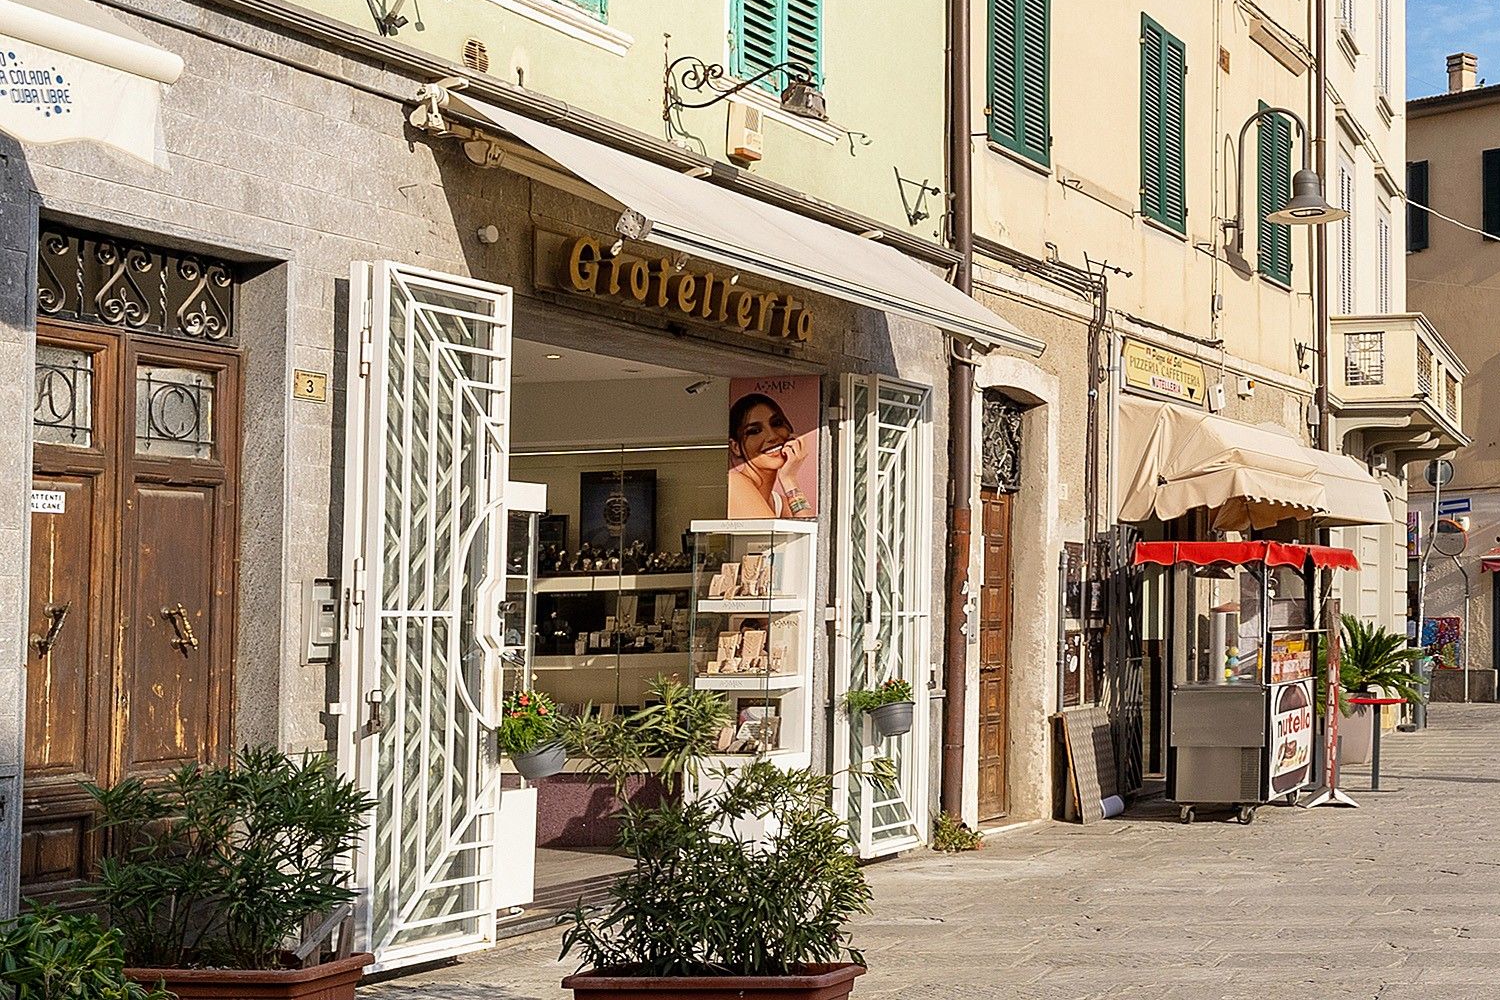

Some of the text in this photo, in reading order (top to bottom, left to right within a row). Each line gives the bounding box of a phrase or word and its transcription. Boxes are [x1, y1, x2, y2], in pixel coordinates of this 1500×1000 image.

[9, 70, 52, 85] COLADA
[11, 88, 72, 104] CUBA LIBRE
[570, 235, 815, 342] Gioielleria
[1129, 355, 1201, 388] PIZZERIA CAFFETTERIA
[306, 379, 314, 393] 3
[31, 493, 62, 501] ATTENTI
[41, 502, 60, 510] CANE
[1277, 706, 1311, 738] nutella
